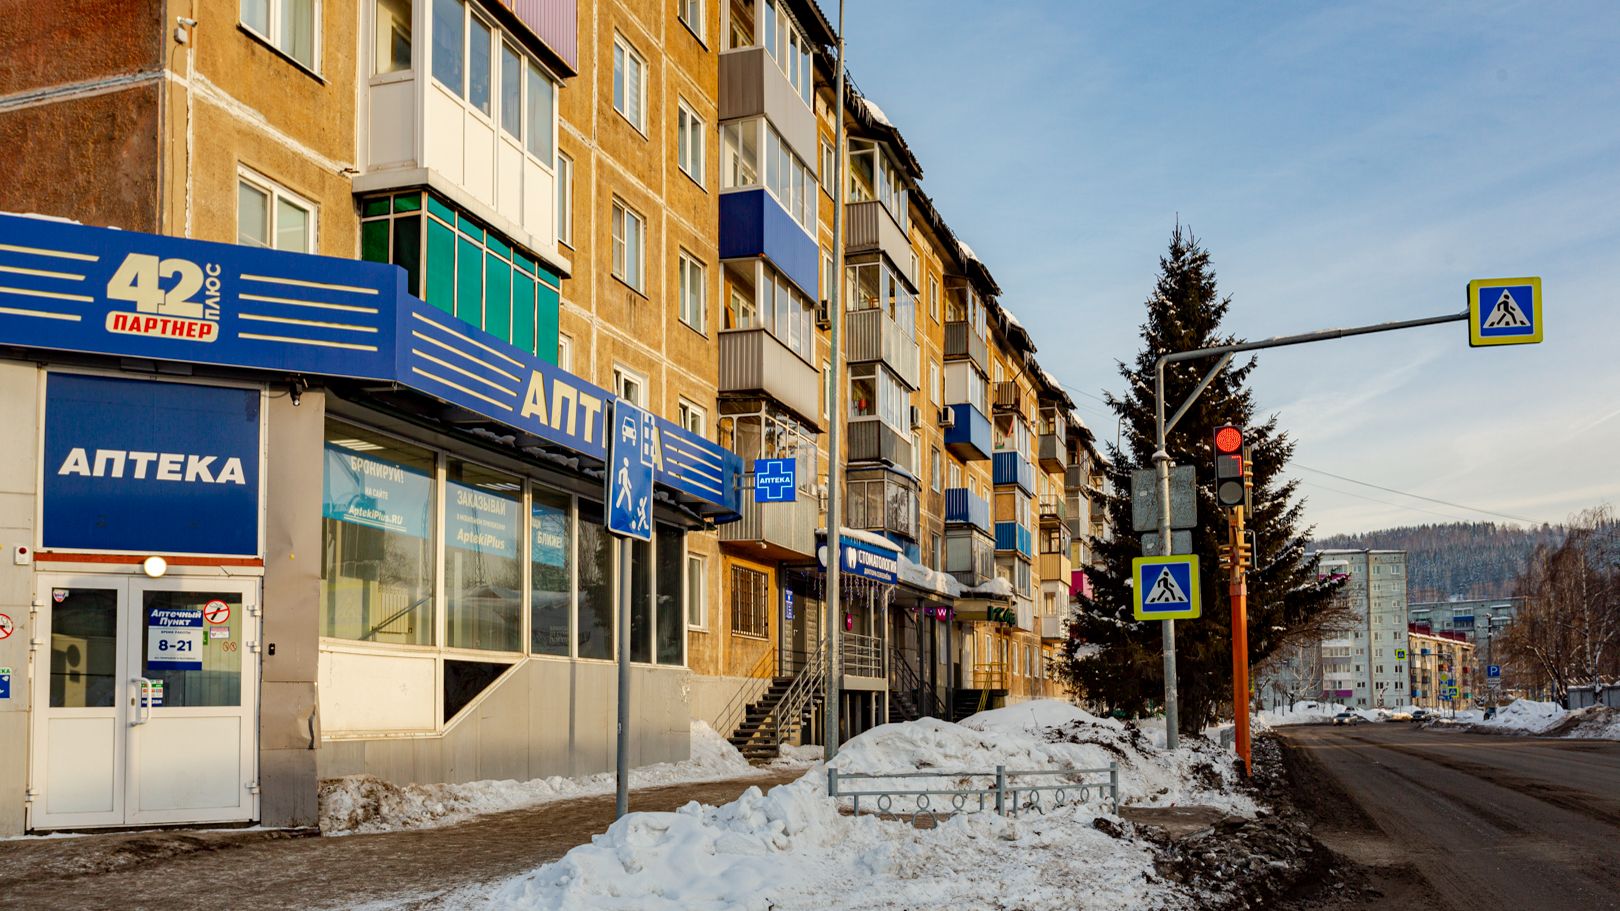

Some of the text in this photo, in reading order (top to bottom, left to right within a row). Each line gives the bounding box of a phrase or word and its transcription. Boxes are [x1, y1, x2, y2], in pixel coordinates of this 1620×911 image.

[106, 252, 204, 319] 42
[205, 263, 221, 320] ПЛЮС
[113, 314, 212, 339] ПАРТНЕР
[520, 369, 664, 473] АПТА
[57, 447, 246, 485] АПТЕКА
[350, 456, 404, 484] БРОНИРУЙ!
[457, 490, 506, 516] ЗАКАЗЫВАЙ
[457, 529, 505, 550] AptekiPlus
[151, 609, 201, 619] Аптечный
[159, 618, 192, 627] Пункт
[158, 640, 192, 651] 8-21
[1490, 666, 1498, 676] P
